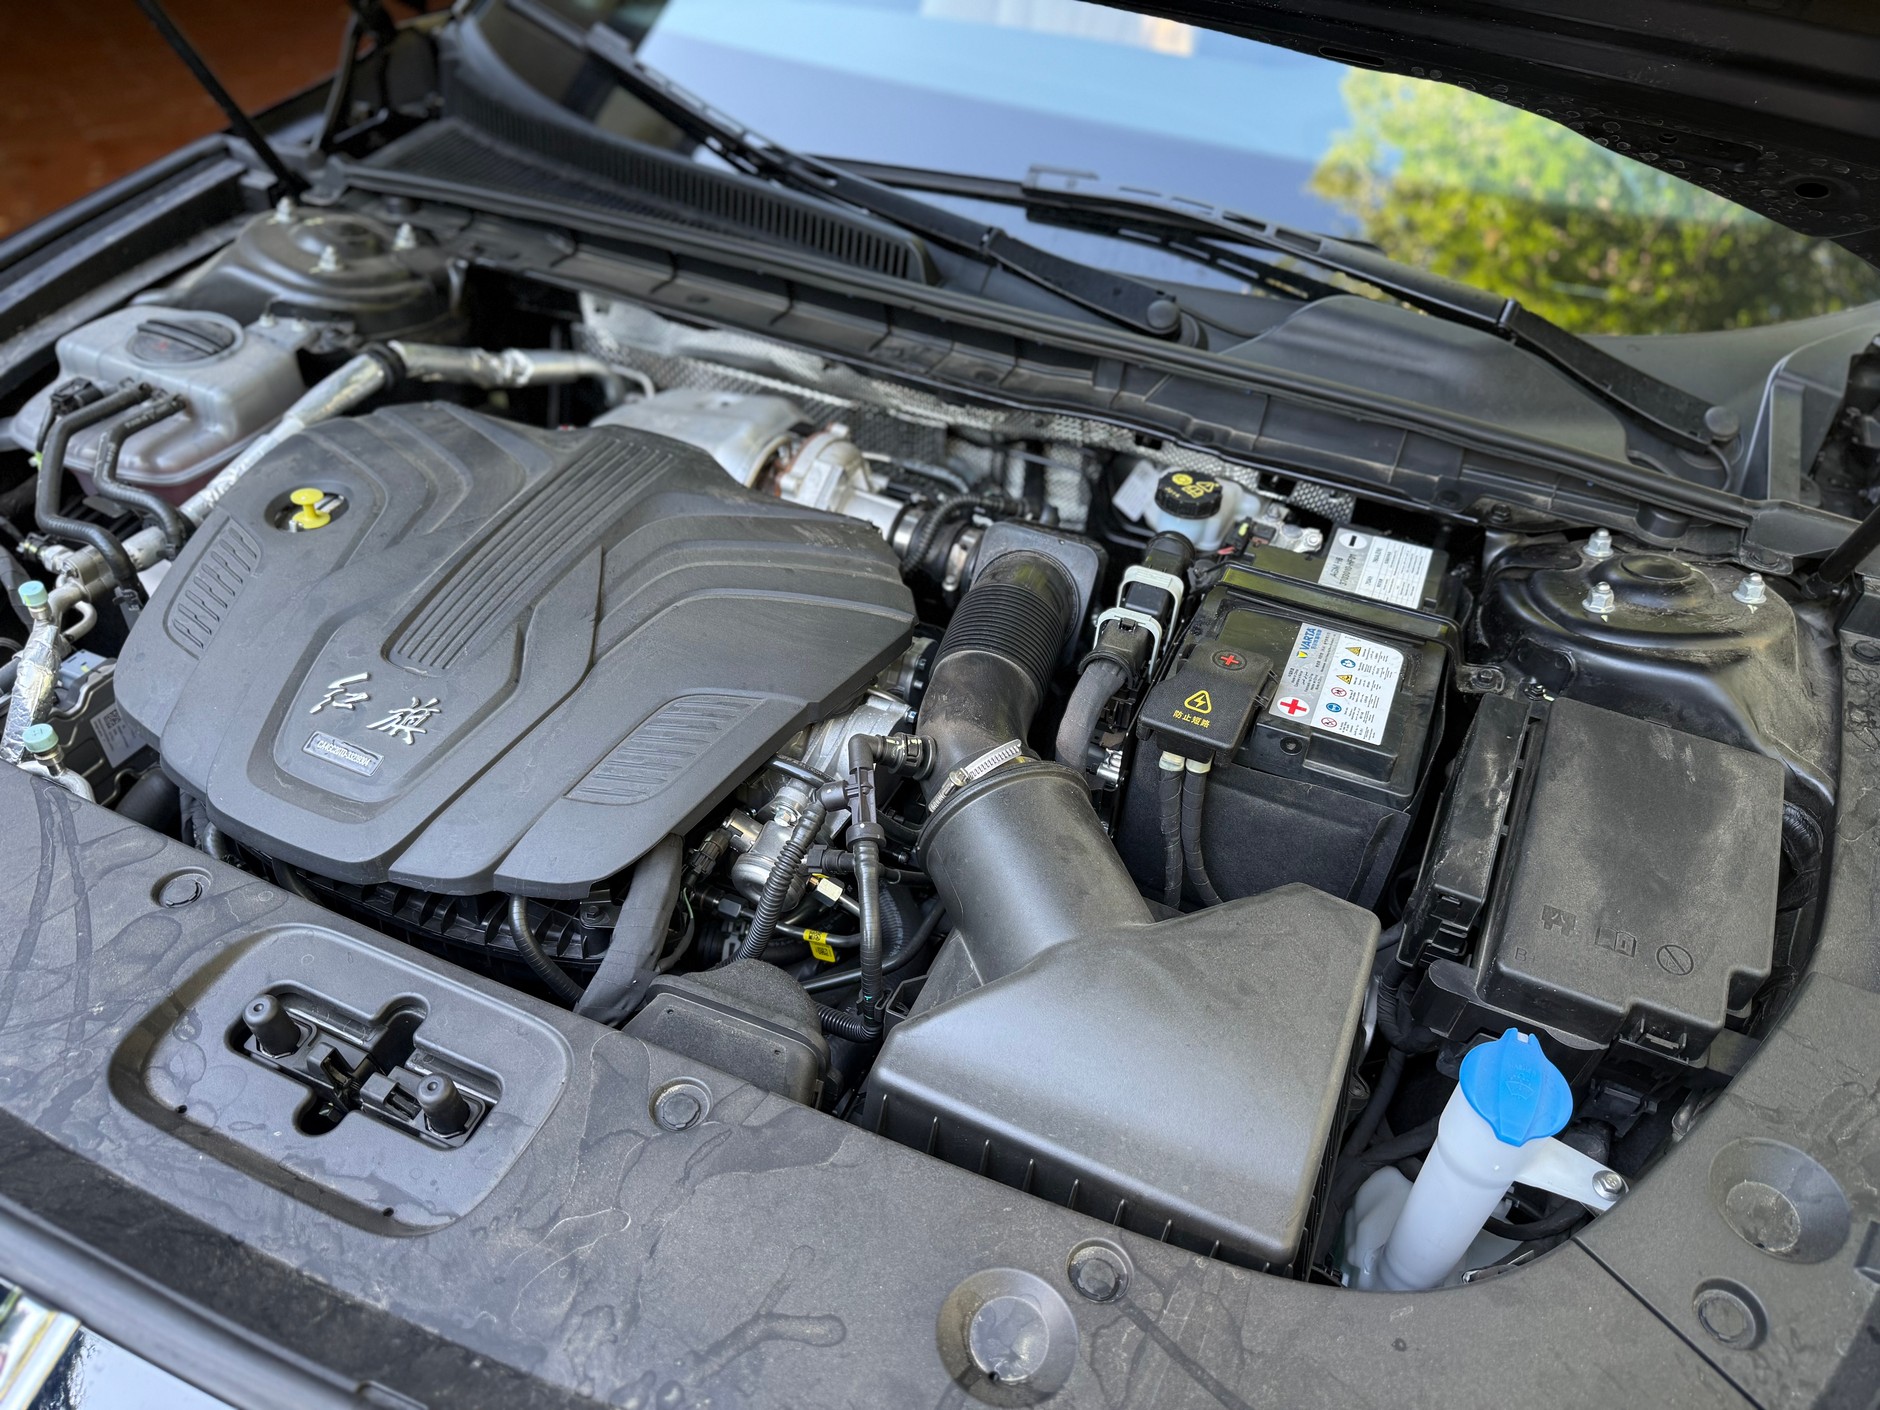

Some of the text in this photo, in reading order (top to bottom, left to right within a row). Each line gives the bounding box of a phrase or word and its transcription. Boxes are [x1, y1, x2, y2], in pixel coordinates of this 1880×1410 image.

[1299, 628, 1316, 650] VARTA
[1172, 709, 1211, 729] 防止短路
